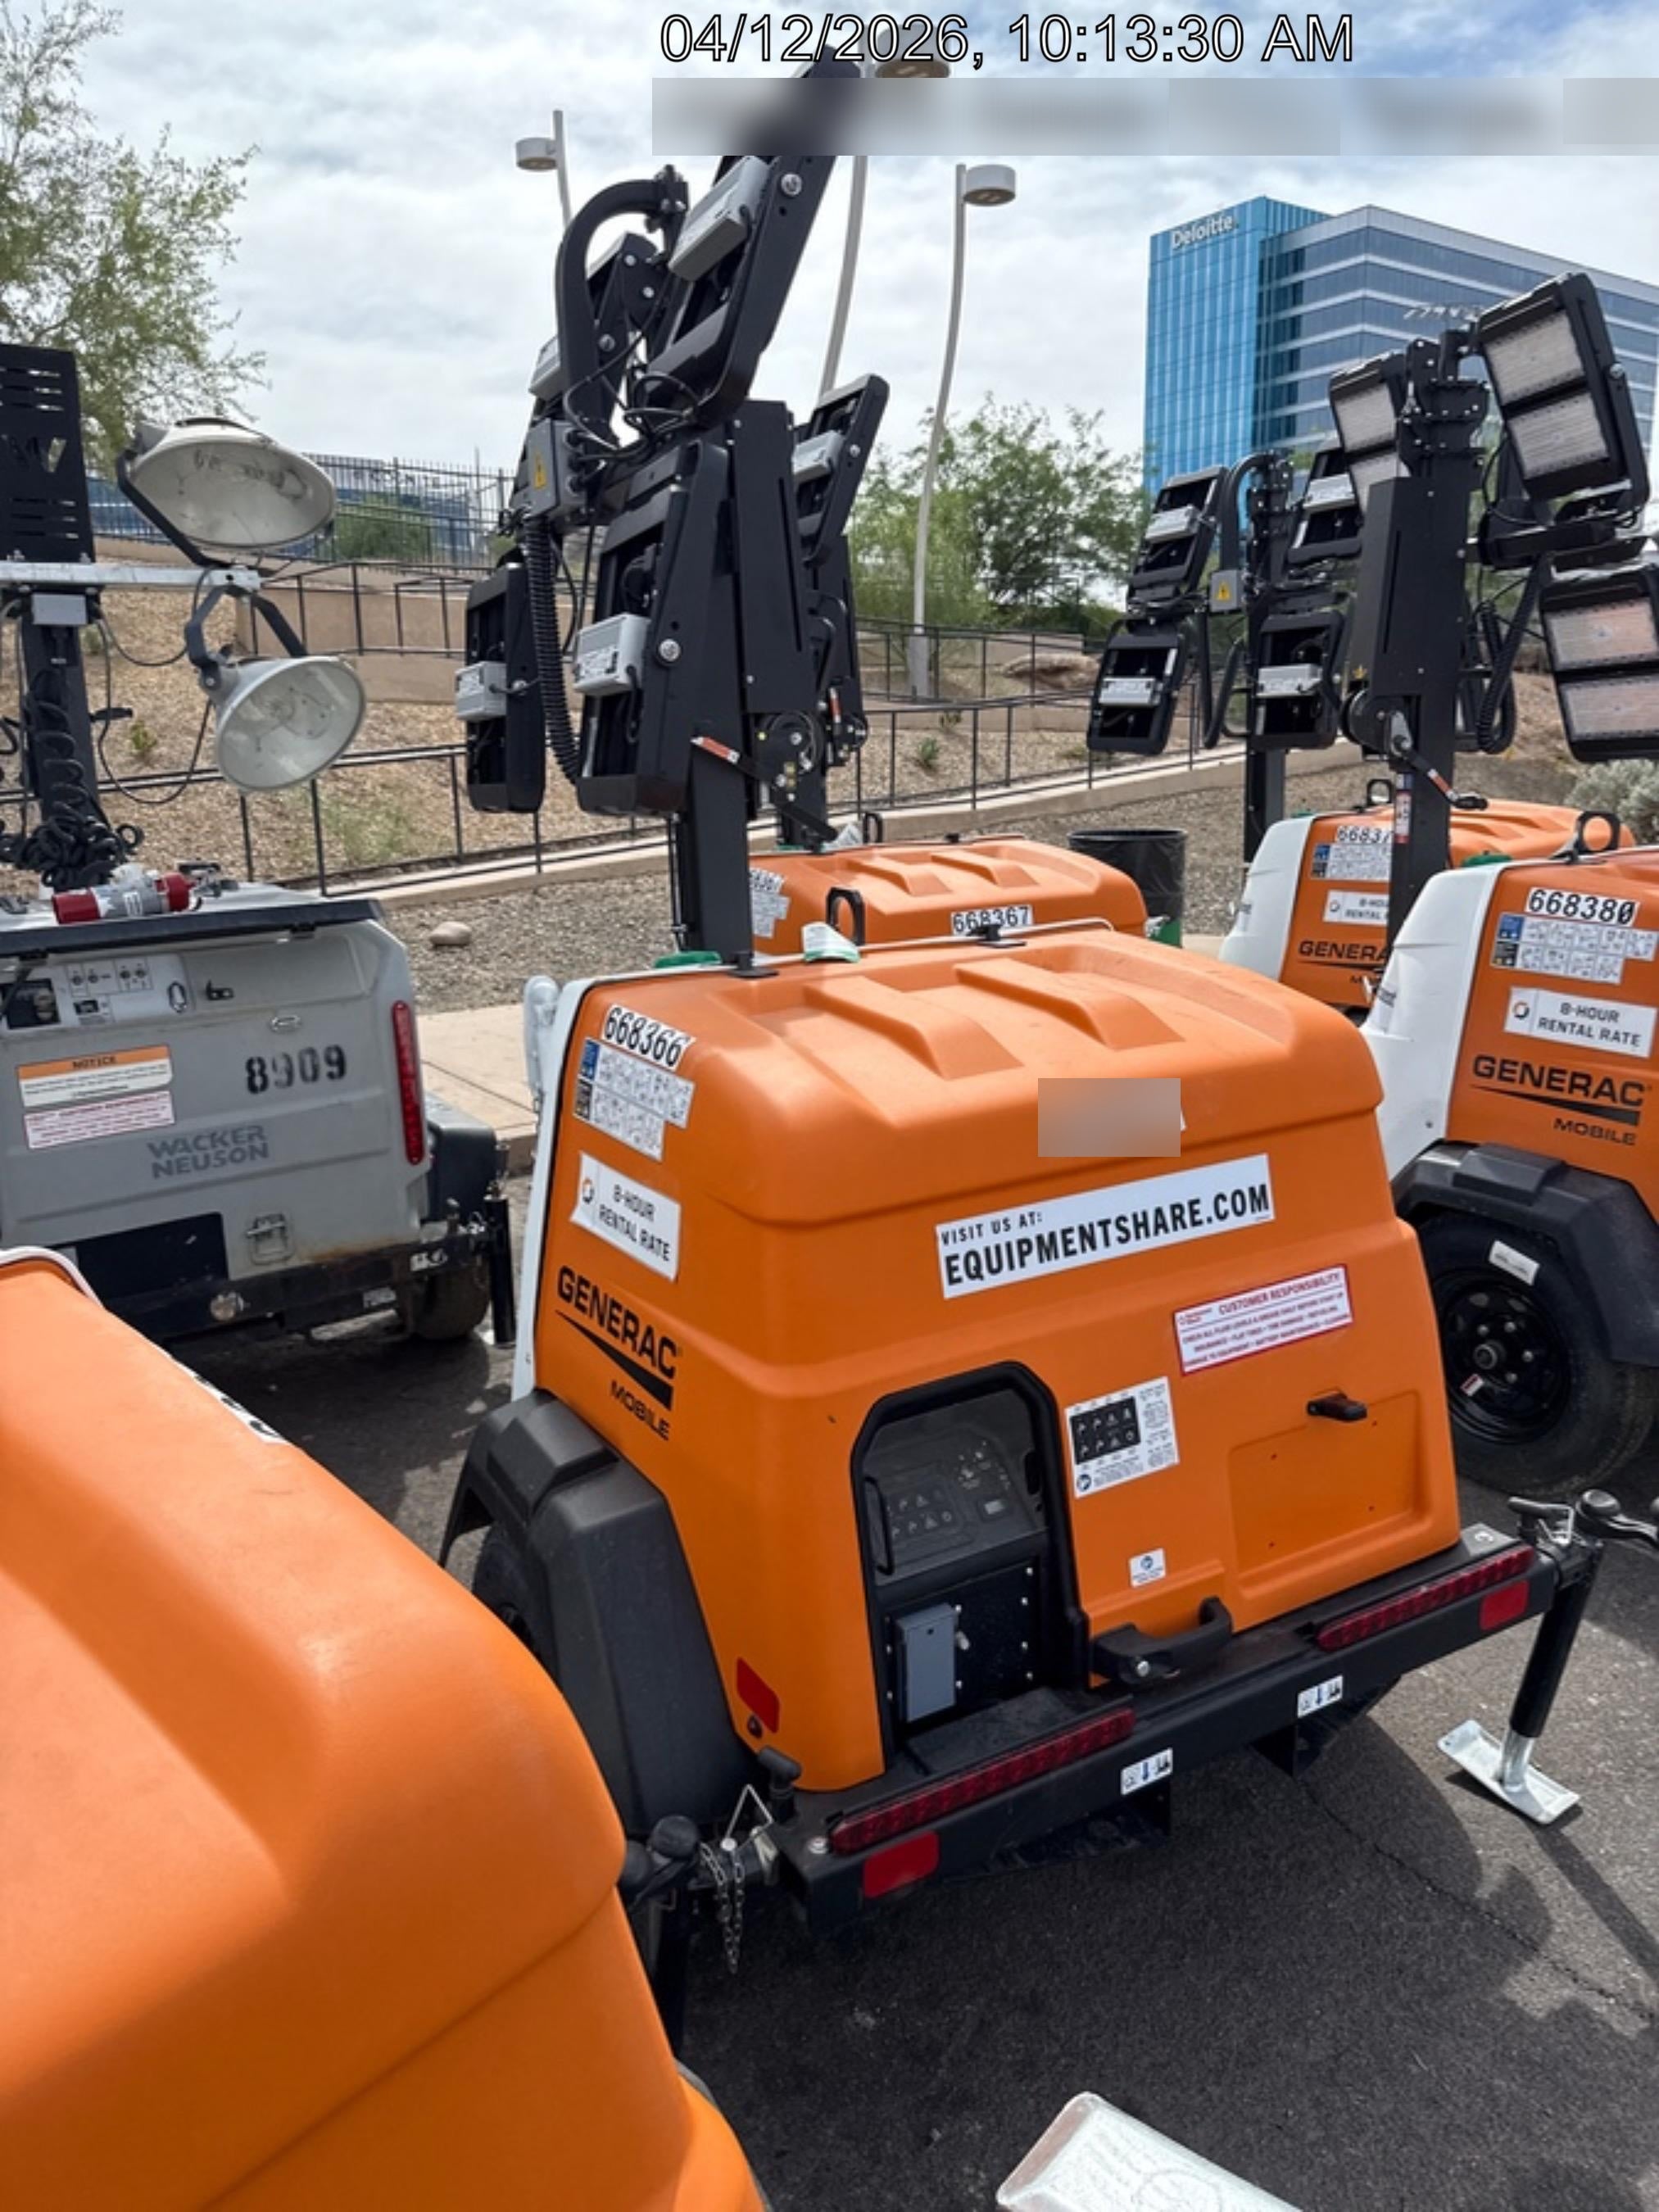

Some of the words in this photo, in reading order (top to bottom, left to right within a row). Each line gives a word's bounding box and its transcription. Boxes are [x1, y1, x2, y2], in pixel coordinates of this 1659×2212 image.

[954, 906, 1028, 932] 668367
[1529, 889, 1635, 925] 668380
[1559, 1002, 1620, 1023] 8-HOUR
[604, 1006, 690, 1067] 668366
[1537, 1017, 1594, 1038] RENTAL
[1599, 1027, 1642, 1047] RATE
[245, 1044, 347, 1095] 8909
[1472, 1054, 1645, 1107] GENERAC
[147, 1125, 268, 1159] WACKER
[1553, 1117, 1637, 1146] MOBILE
[151, 1142, 270, 1180] NEUSON
[599, 1203, 637, 1243] RENTAL
[639, 1228, 670, 1262] RATE
[941, 1223, 985, 1247] VISIT
[990, 1219, 1012, 1235] US
[1018, 1211, 1043, 1229] AT:
[945, 1183, 1270, 1286] EQUIPMENTSHARE.COM
[557, 1265, 678, 1380] GENERAC
[610, 1379, 670, 1441] MOBILE
